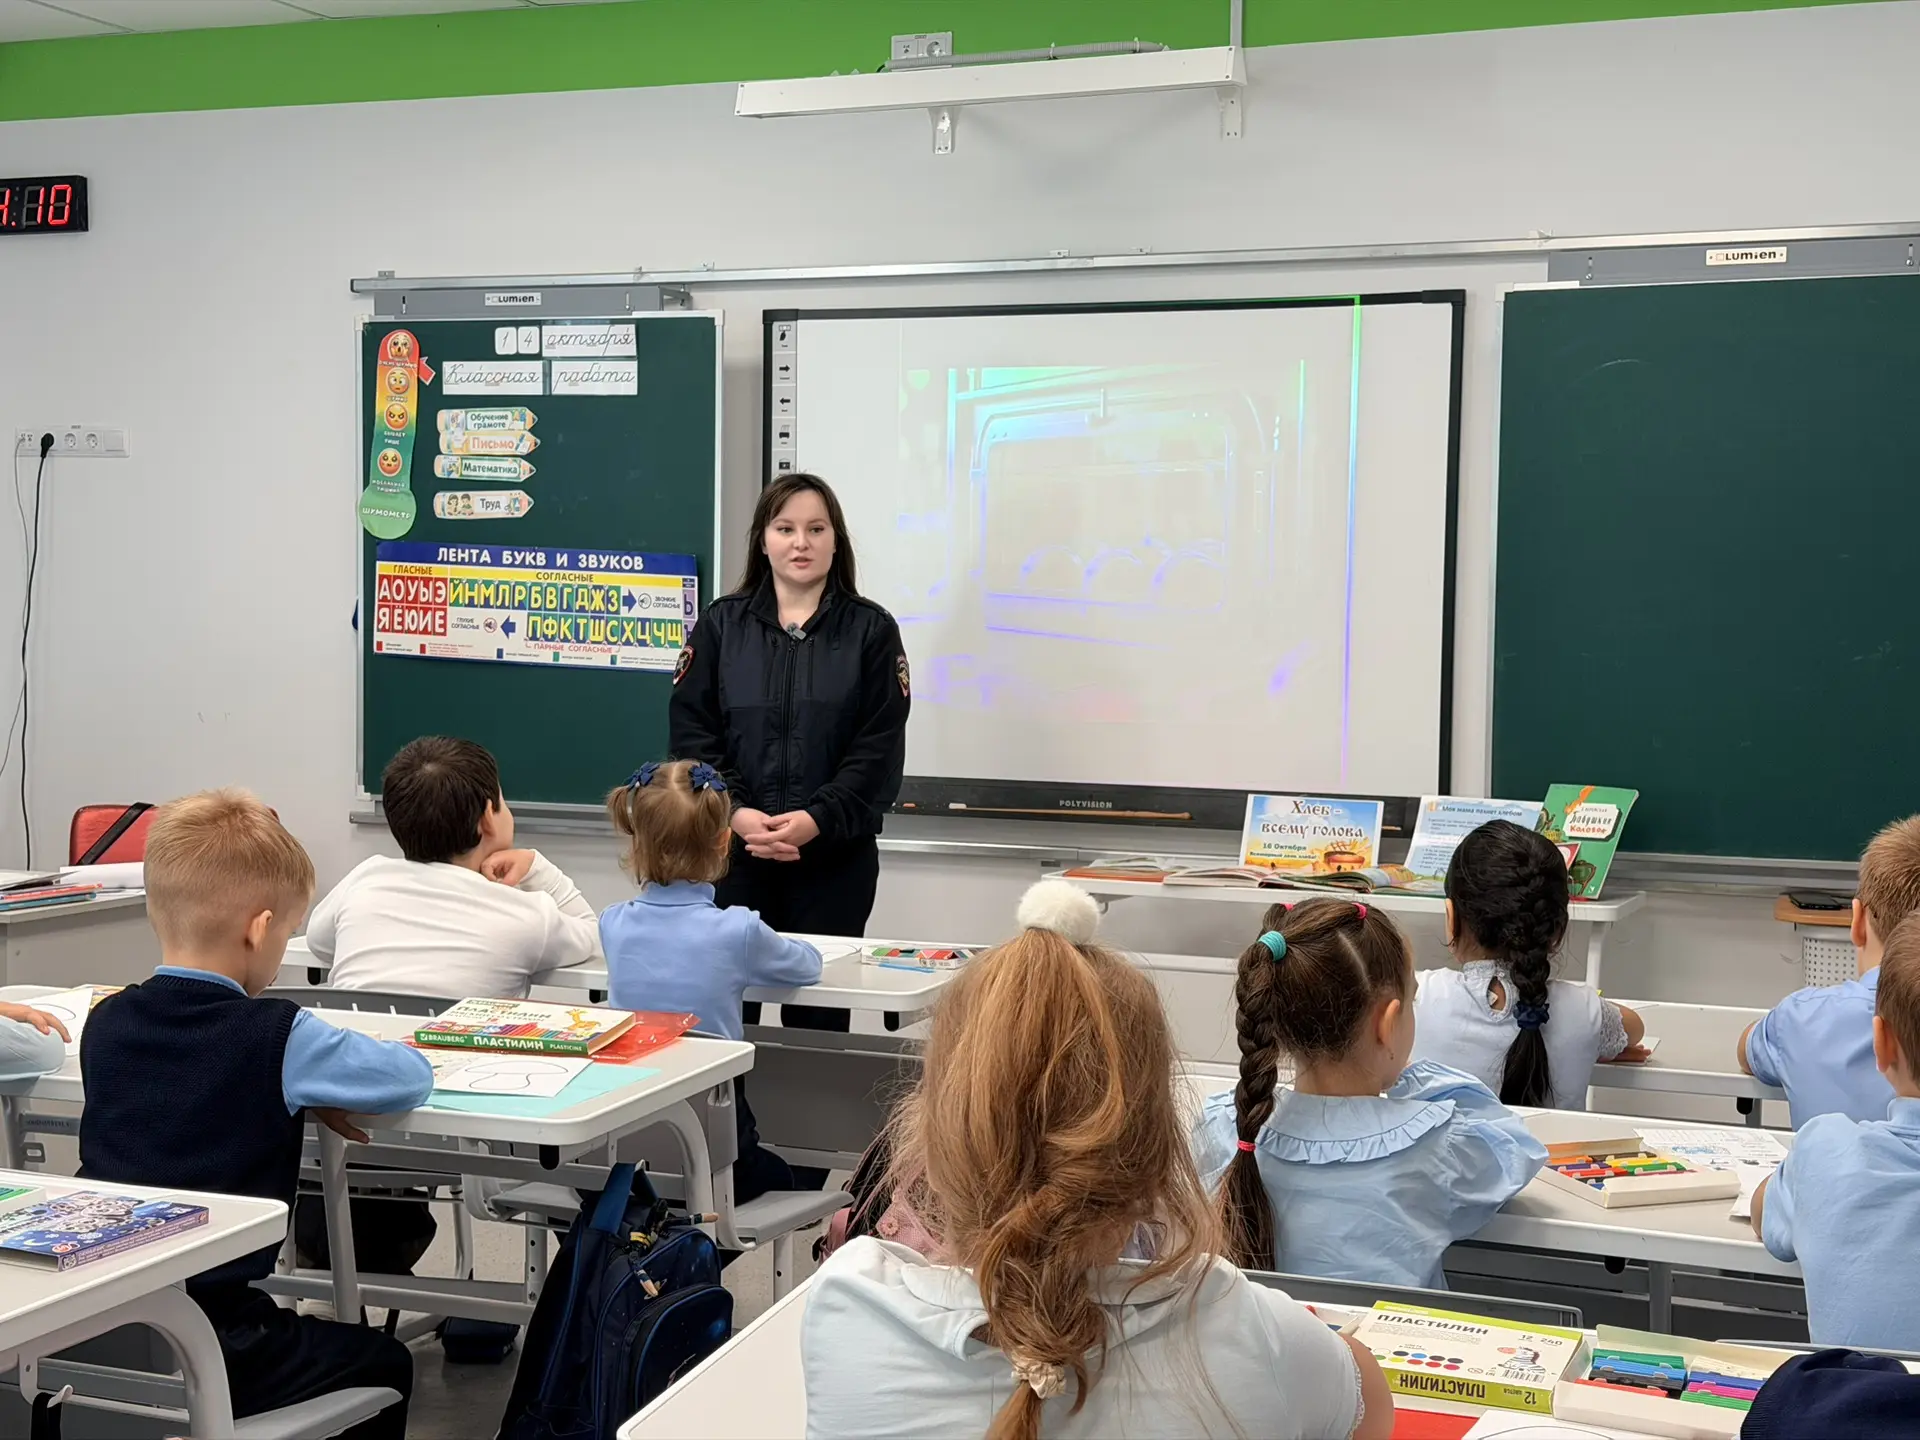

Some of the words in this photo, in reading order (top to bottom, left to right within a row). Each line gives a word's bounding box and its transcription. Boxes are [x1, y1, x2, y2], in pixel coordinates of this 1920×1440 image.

[470, 413, 509, 422] Обучение
[473, 422, 506, 430] грамоте
[472, 436, 515, 449] Письмо
[463, 462, 518, 475] Математика
[480, 498, 501, 510] Труд
[437, 547, 492, 564] ЛЕНТА
[502, 550, 547, 566] БУКВ
[556, 552, 568, 567] И
[578, 553, 644, 570] ЗВУКОВ
[393, 565, 433, 575] ГЛАСНЫЕ
[536, 572, 594, 583] СОГЛАСНЫЕ
[534, 642, 564, 651] ПАРНЫЕ
[568, 644, 613, 653] СОГЛАСНЫЕ
[1059, 799, 1113, 809] POLYVISION
[1274, 843, 1307, 852] Октября
[473, 1035, 545, 1050] ПЛАСТИЛИН
[550, 1043, 583, 1052] PLASTICINE
[1377, 1314, 1489, 1335] ПЛАСТИЛИН
[1400, 1373, 1486, 1399] ПЛАСТИЛИН
[1524, 1391, 1537, 1405] 12
